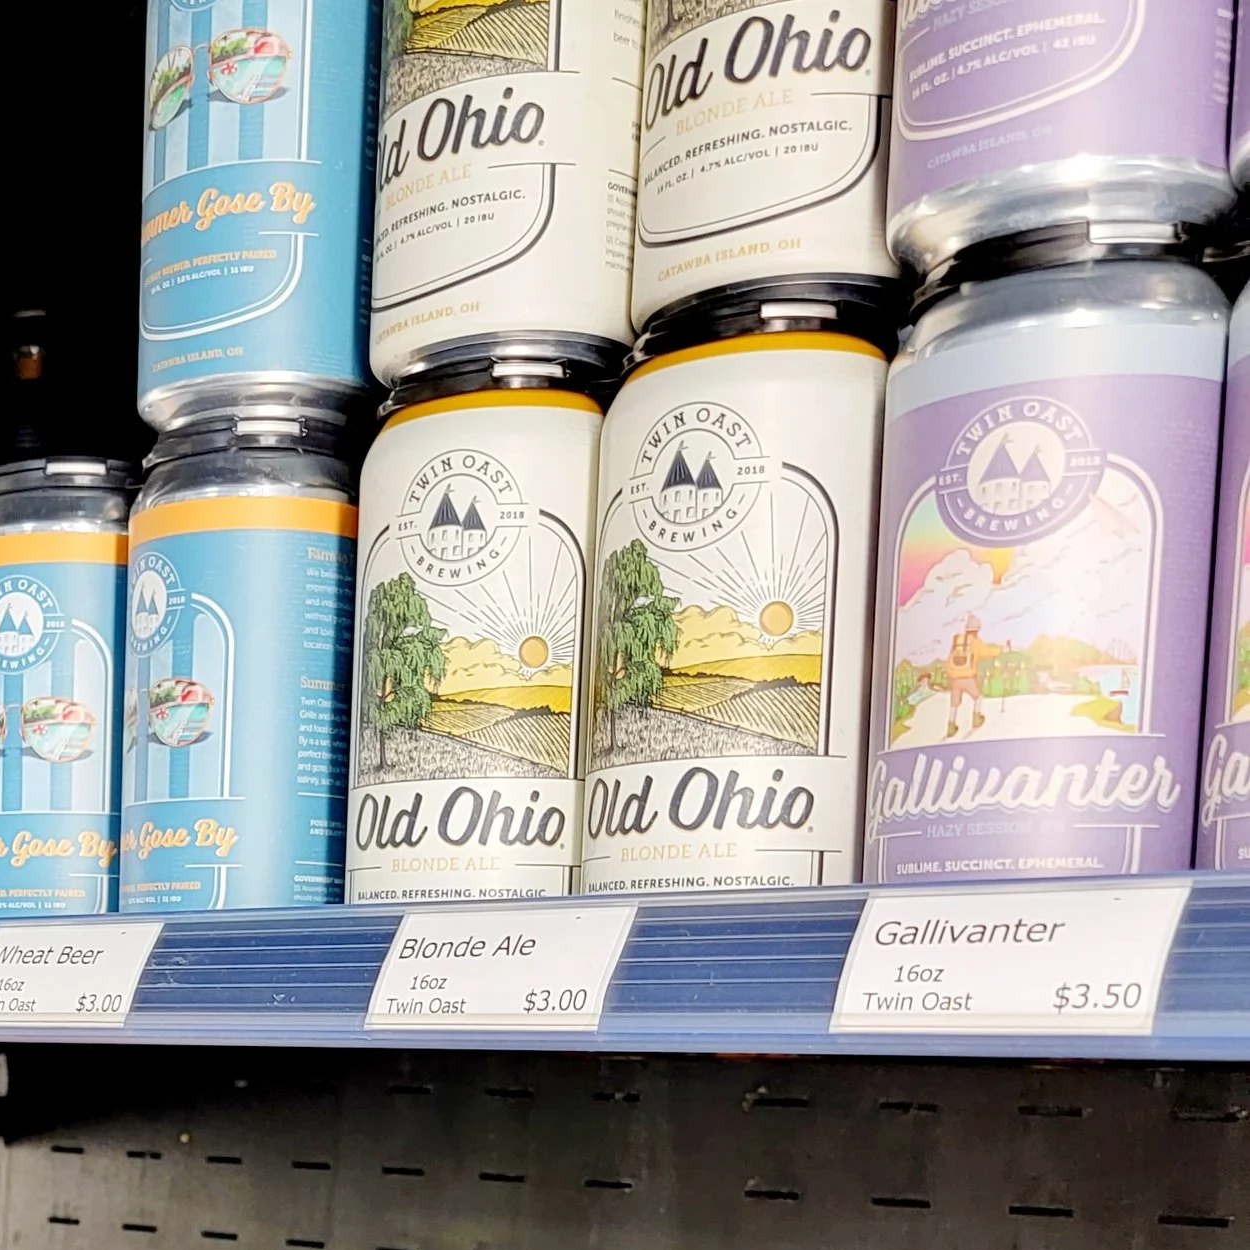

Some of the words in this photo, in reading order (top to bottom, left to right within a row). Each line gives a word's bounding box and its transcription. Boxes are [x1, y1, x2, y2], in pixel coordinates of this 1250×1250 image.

[1016, 10, 1106, 39] EPHEMERAL.
[645, 37, 714, 132] Old
[723, 9, 871, 84] Ohio
[675, 97, 748, 137] BLONDE
[751, 88, 794, 111] ALE
[377, 120, 410, 192] ld
[417, 87, 545, 161] Ohio
[684, 129, 765, 160] REFRESHING.
[768, 119, 853, 138] NOSTALGIC.
[385, 173, 435, 210] BLONDE
[438, 164, 472, 185] ALE
[390, 202, 449, 234] REFRESHING.
[451, 189, 526, 210] NOSTALGIC.
[640, 411, 688, 464] TWIN
[695, 407, 752, 449] OAST
[955, 403, 1013, 457] TWIN
[1022, 399, 1083, 443] OAST
[409, 456, 454, 505] TWIN
[462, 454, 513, 494] OAST
[630, 483, 650, 496] EST.
[736, 464, 766, 476] 2018
[499, 510, 525, 520] 2018
[648, 508, 738, 543] BREWING
[962, 495, 1067, 533] BREWING
[415, 548, 500, 579] BREWING
[17, 577, 55, 611] OAST
[587, 774, 659, 840] Old
[668, 766, 815, 832] Ohio
[865, 747, 1181, 845] Gallivanter
[355, 792, 429, 852] Old
[437, 785, 566, 847] Ohio
[137, 822, 190, 860] Gose
[194, 817, 238, 857] By
[620, 843, 692, 863] BLONDE
[698, 842, 739, 859] ALE
[391, 856, 461, 873] BLONDE
[464, 856, 501, 872] ALE
[630, 876, 710, 890] REFRESHING.
[713, 875, 795, 888] NOSTALGIC.
[398, 935, 486, 960] Blonde
[492, 934, 537, 957] Ale
[874, 917, 1066, 946] Gallivanter
[57, 945, 105, 965] Beer
[409, 974, 448, 991] 16oz
[893, 964, 945, 984] 16oz
[8, 997, 37, 1012] Oast
[75, 993, 123, 1013] $3.00
[386, 998, 423, 1015] Twin
[428, 997, 467, 1014] Oast
[523, 988, 588, 1014] $3.00
[862, 992, 914, 1012] Twin
[921, 991, 973, 1012] Oast
[1051, 981, 1142, 1015] $3.50
